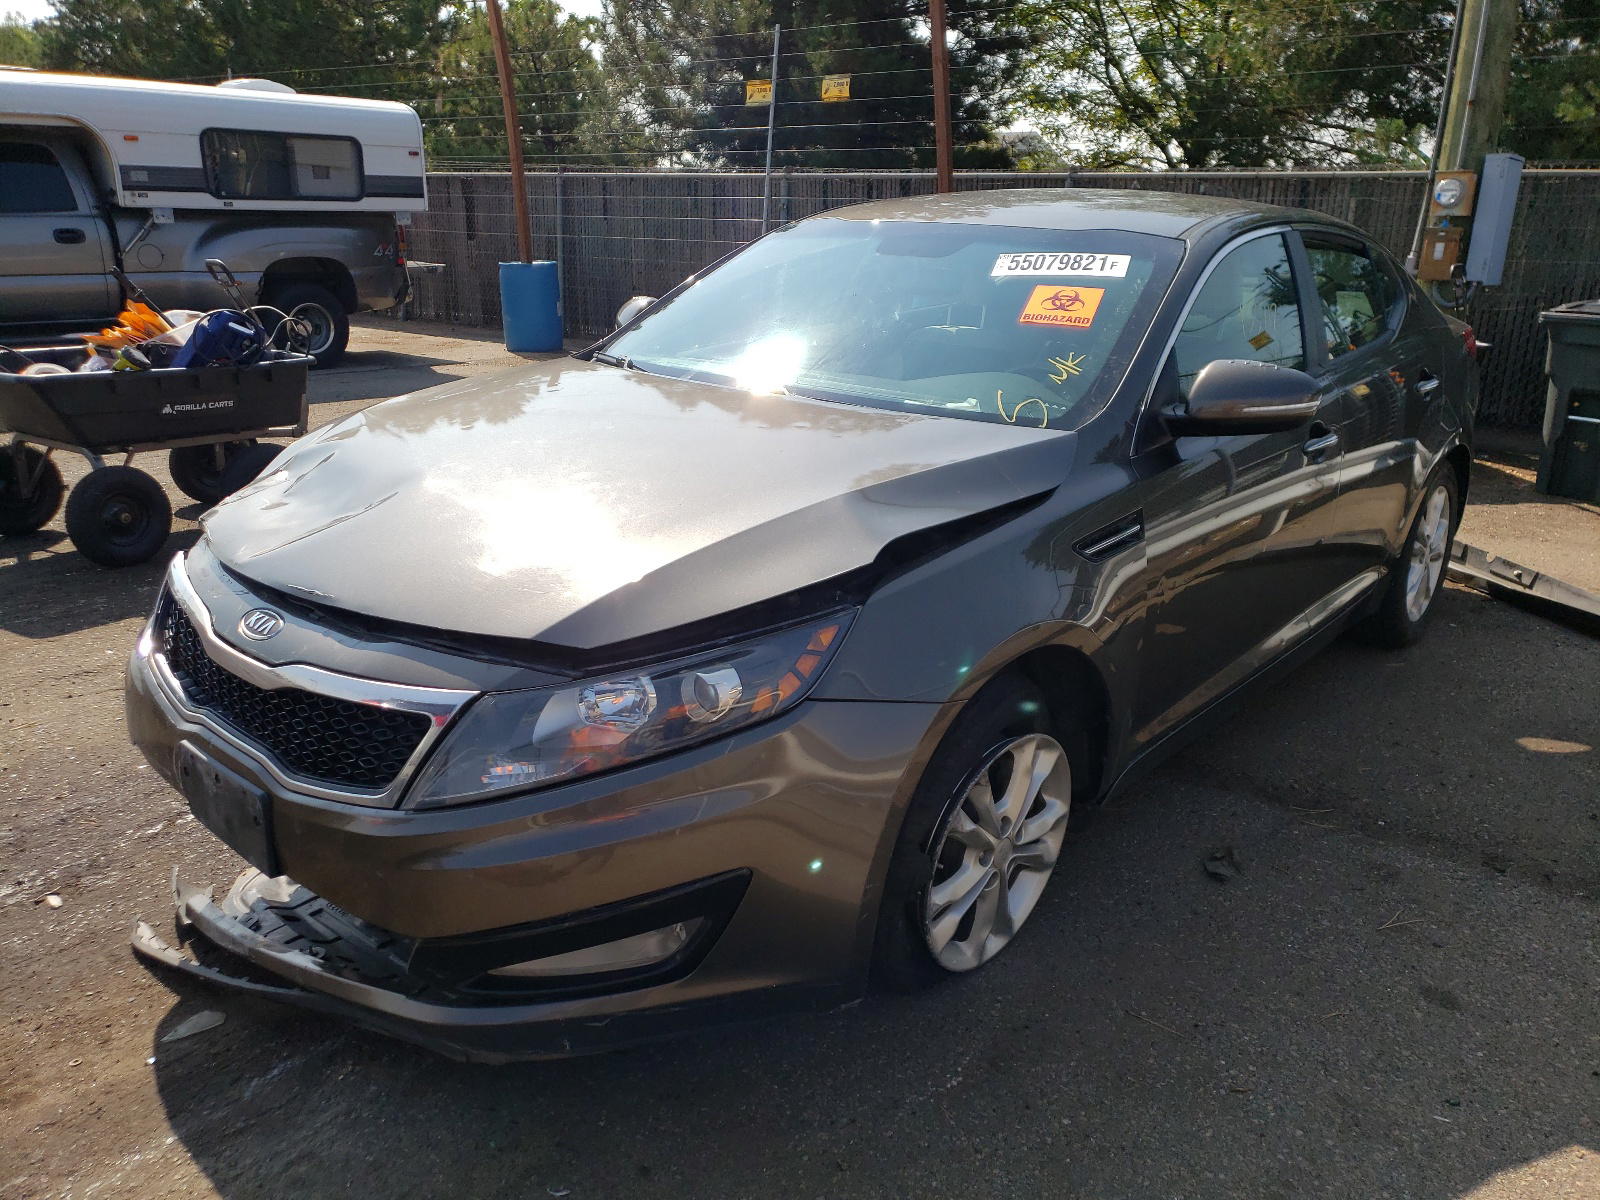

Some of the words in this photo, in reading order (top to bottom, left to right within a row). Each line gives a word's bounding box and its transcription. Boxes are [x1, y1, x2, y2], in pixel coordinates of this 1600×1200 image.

[1007, 253, 1109, 272] 55079821
[1022, 313, 1091, 325] BIOHAZARD
[174, 403, 207, 411] GORILLA
[208, 400, 234, 409] CARTS
[244, 611, 277, 635] KIA
